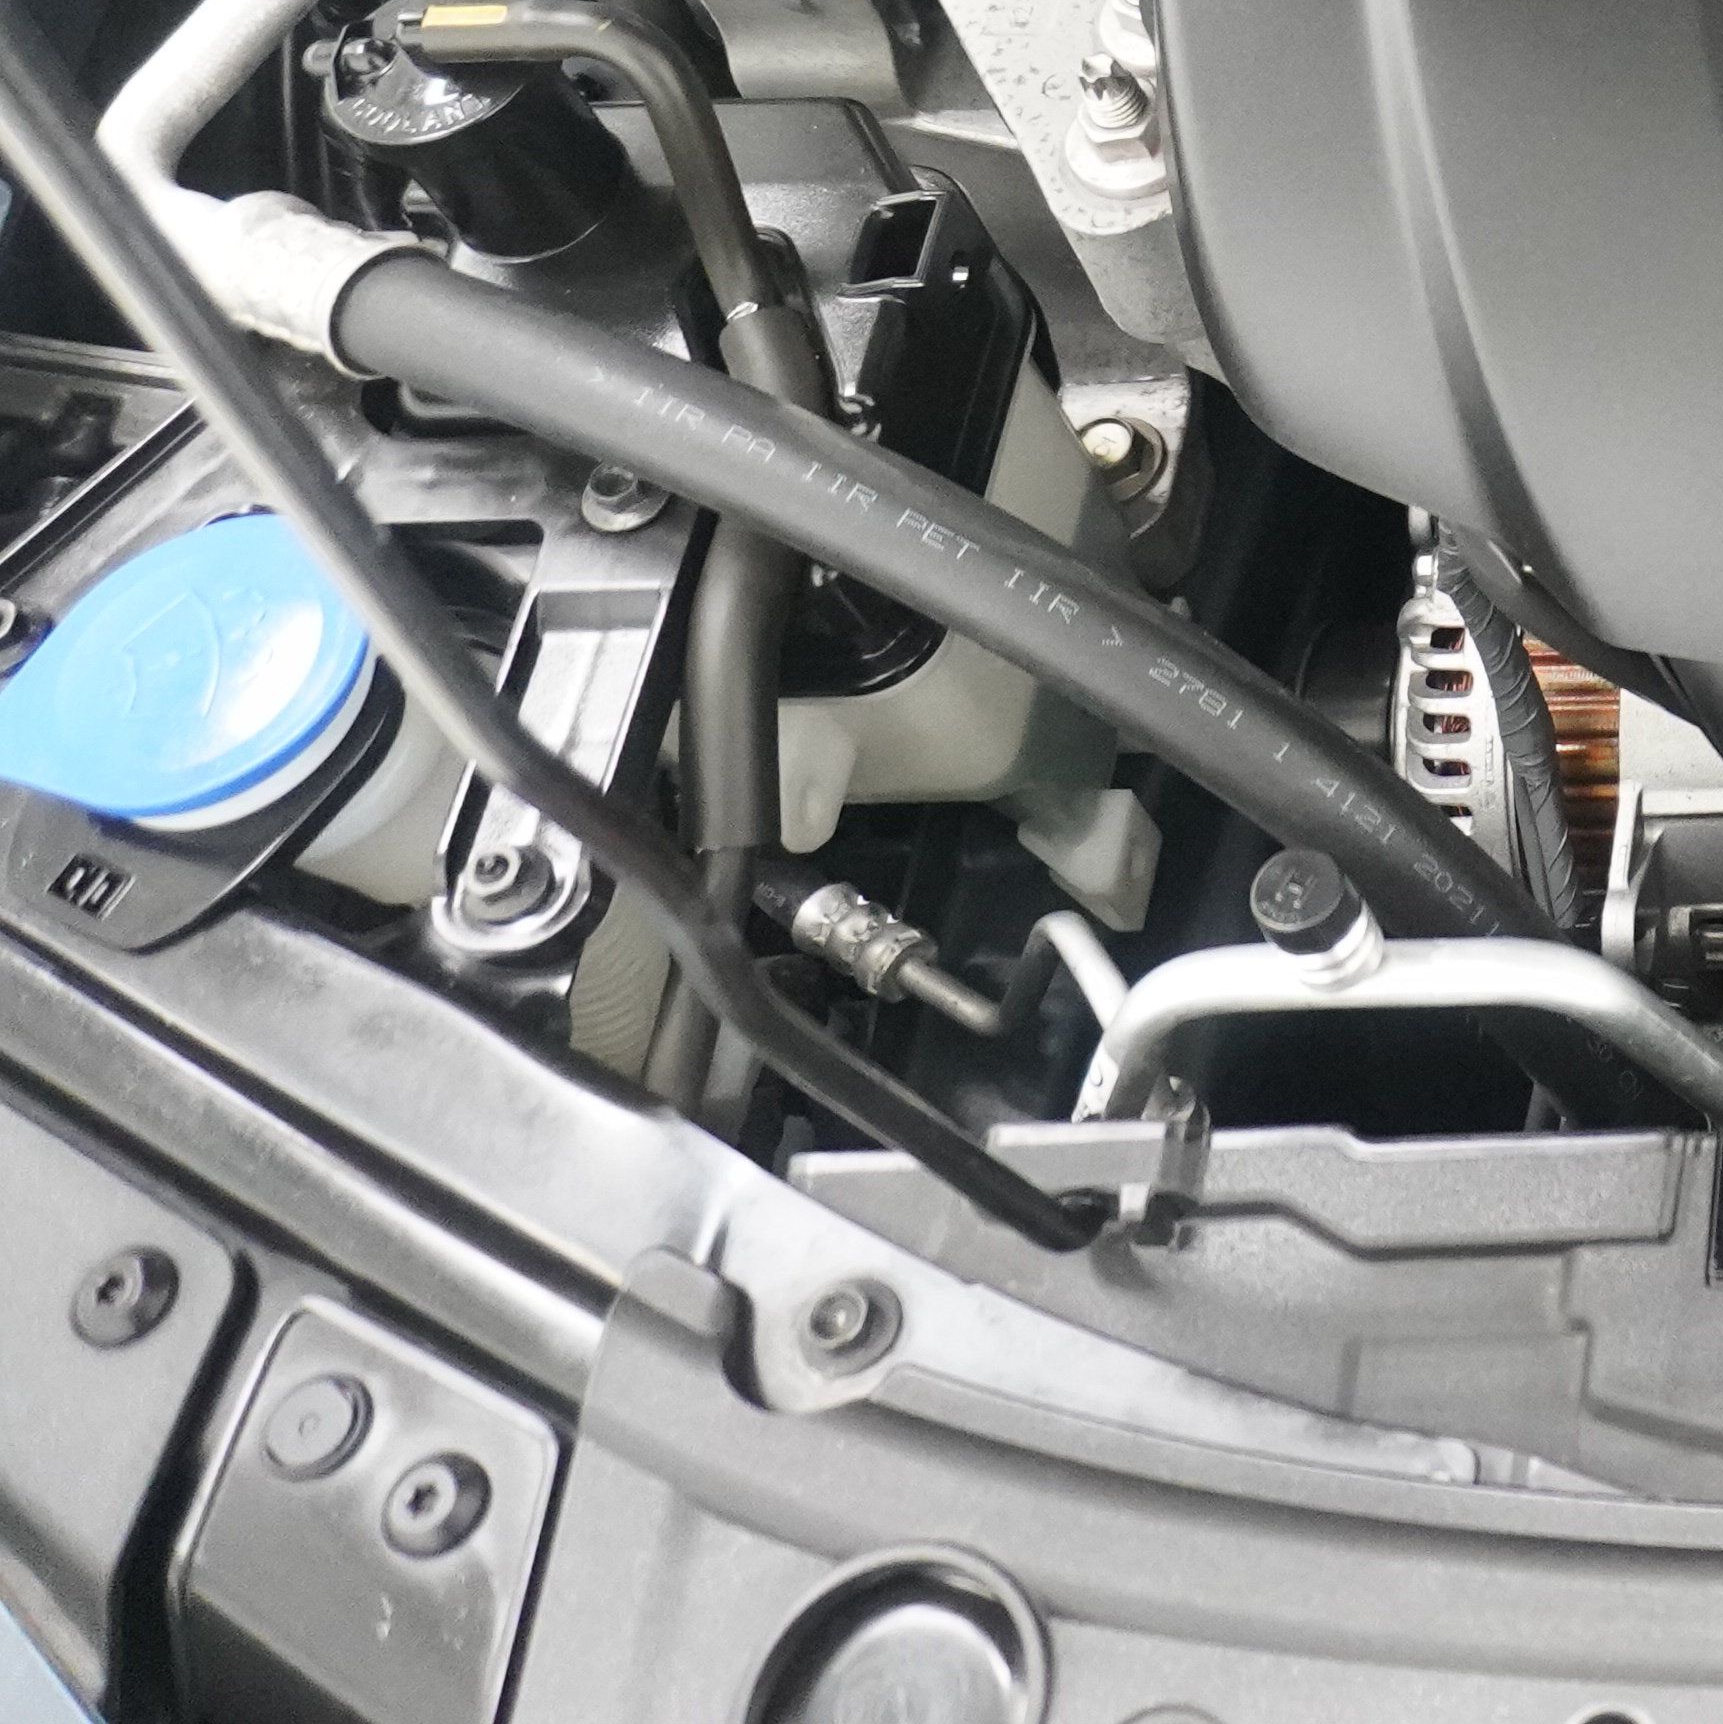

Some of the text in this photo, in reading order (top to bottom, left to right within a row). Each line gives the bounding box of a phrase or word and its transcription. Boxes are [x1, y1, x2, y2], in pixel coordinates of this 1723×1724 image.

[722, 424, 776, 463] PA
[802, 461, 878, 514] IIR
[896, 507, 981, 560] PET
[1004, 569, 1080, 624] IIR
[1315, 777, 1396, 845] 4121
